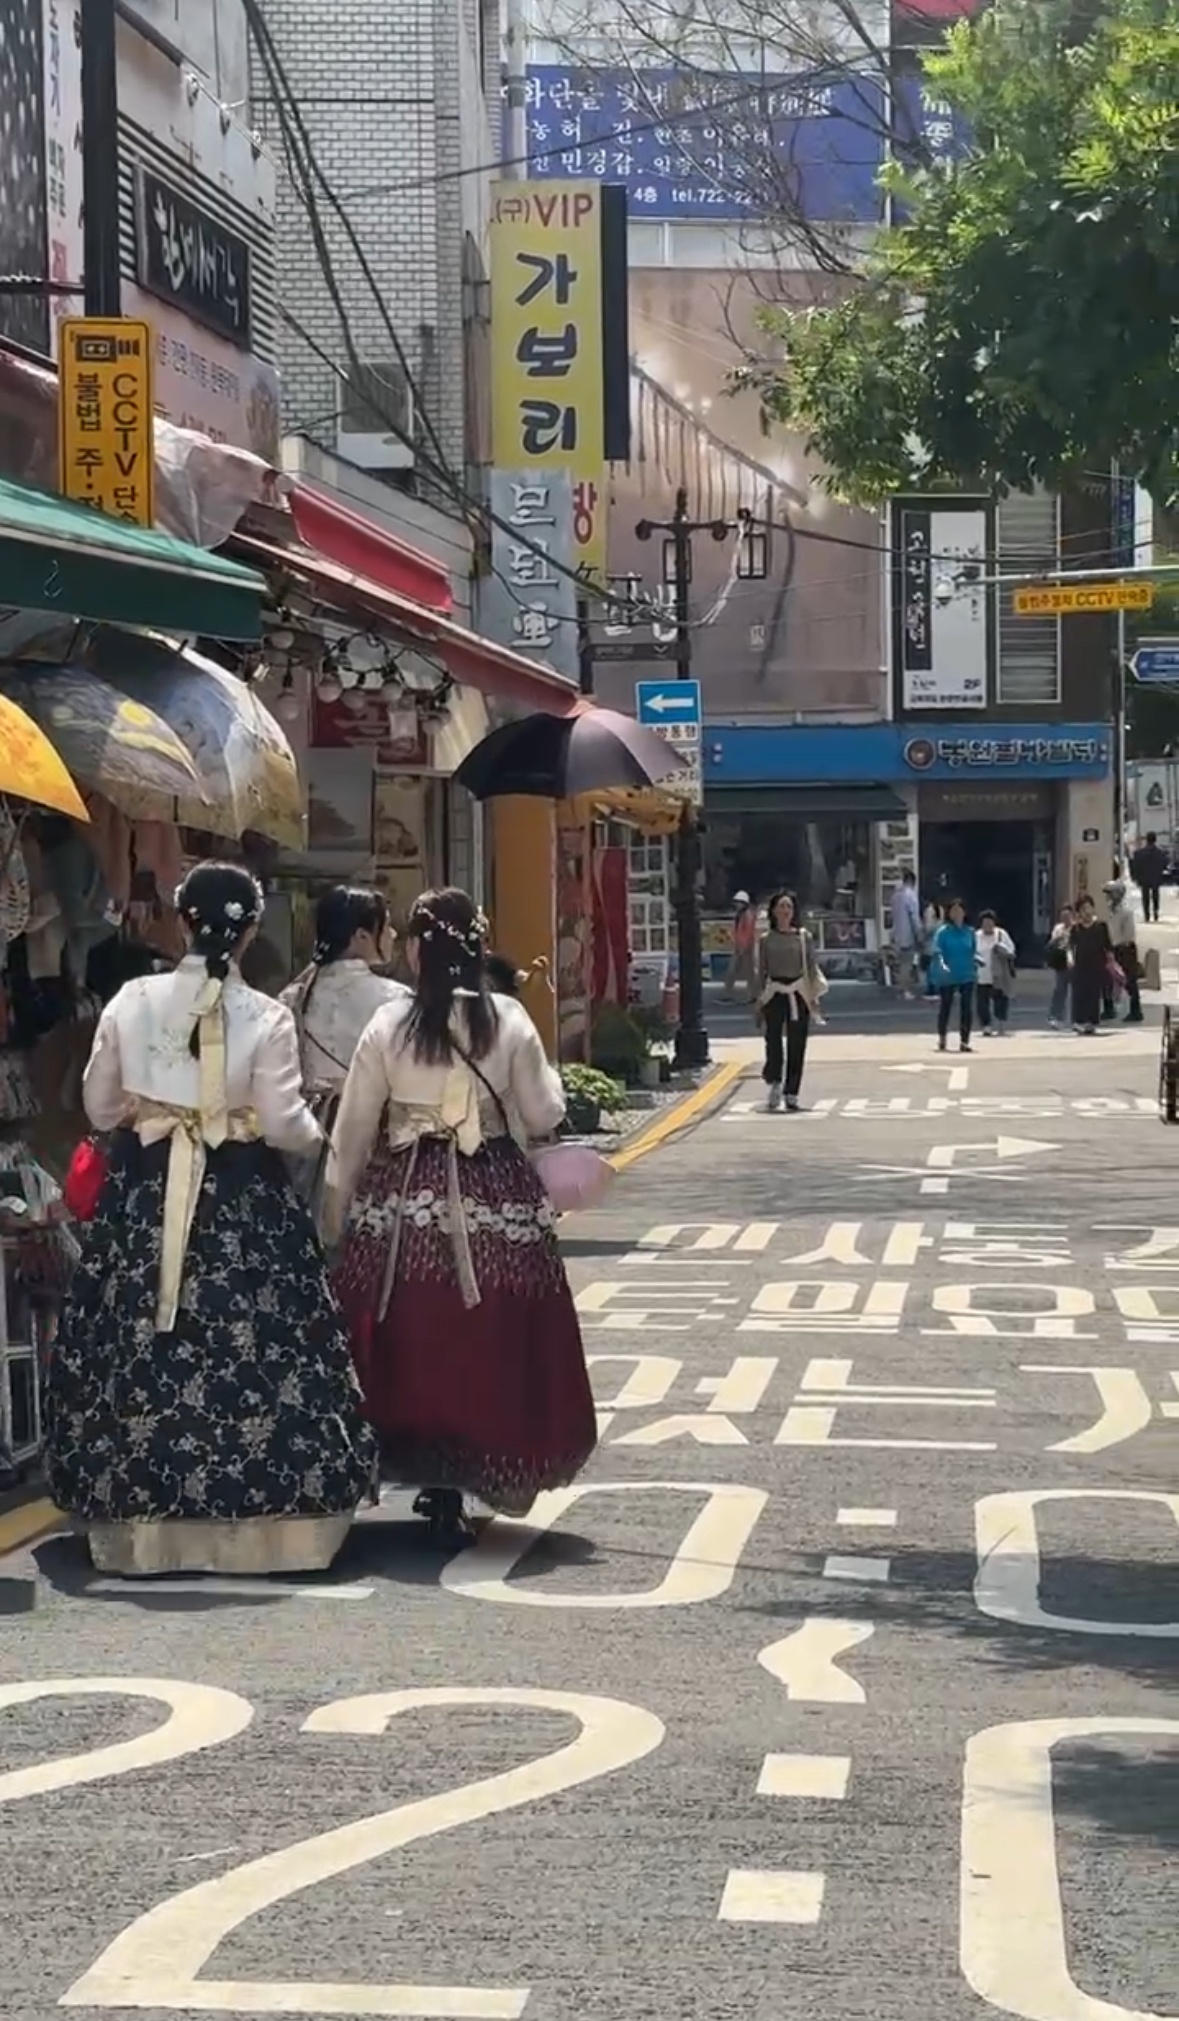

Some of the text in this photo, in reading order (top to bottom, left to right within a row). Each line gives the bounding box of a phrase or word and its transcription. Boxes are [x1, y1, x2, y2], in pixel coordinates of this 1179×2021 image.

[500, 77, 604, 111] 화단을
[526, 119, 550, 140] 농
[514, 252, 578, 455] 가보리
[74, 373, 103, 432] 불법
[112, 373, 139, 478] CCTV
[1075, 591, 1114, 607] CCTV
